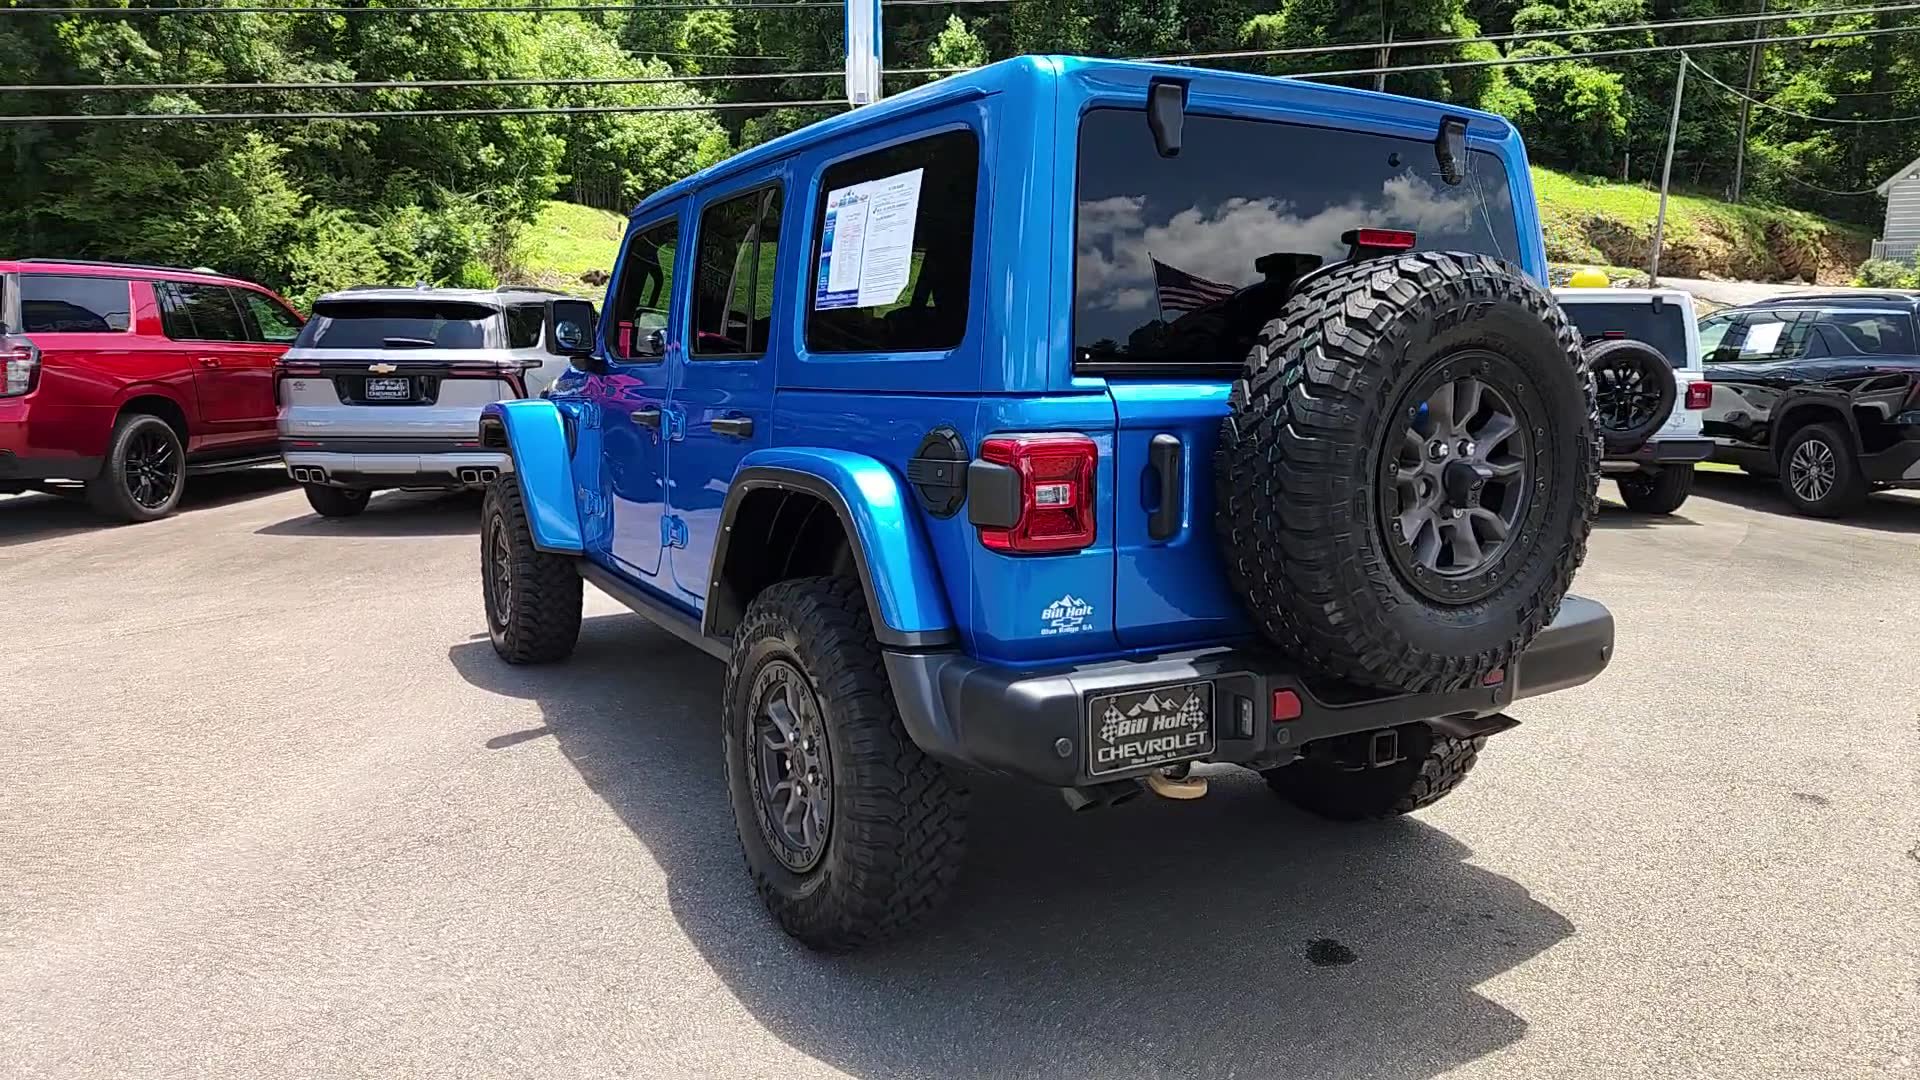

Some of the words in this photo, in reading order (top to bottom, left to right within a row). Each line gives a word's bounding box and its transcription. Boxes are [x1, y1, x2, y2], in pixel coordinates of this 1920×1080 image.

[1041, 607, 1064, 620] Bill
[1065, 605, 1094, 617] Holt
[1116, 717, 1149, 738] Bill
[1151, 711, 1189, 733] Holt
[1097, 730, 1208, 763] CHEVROLET
